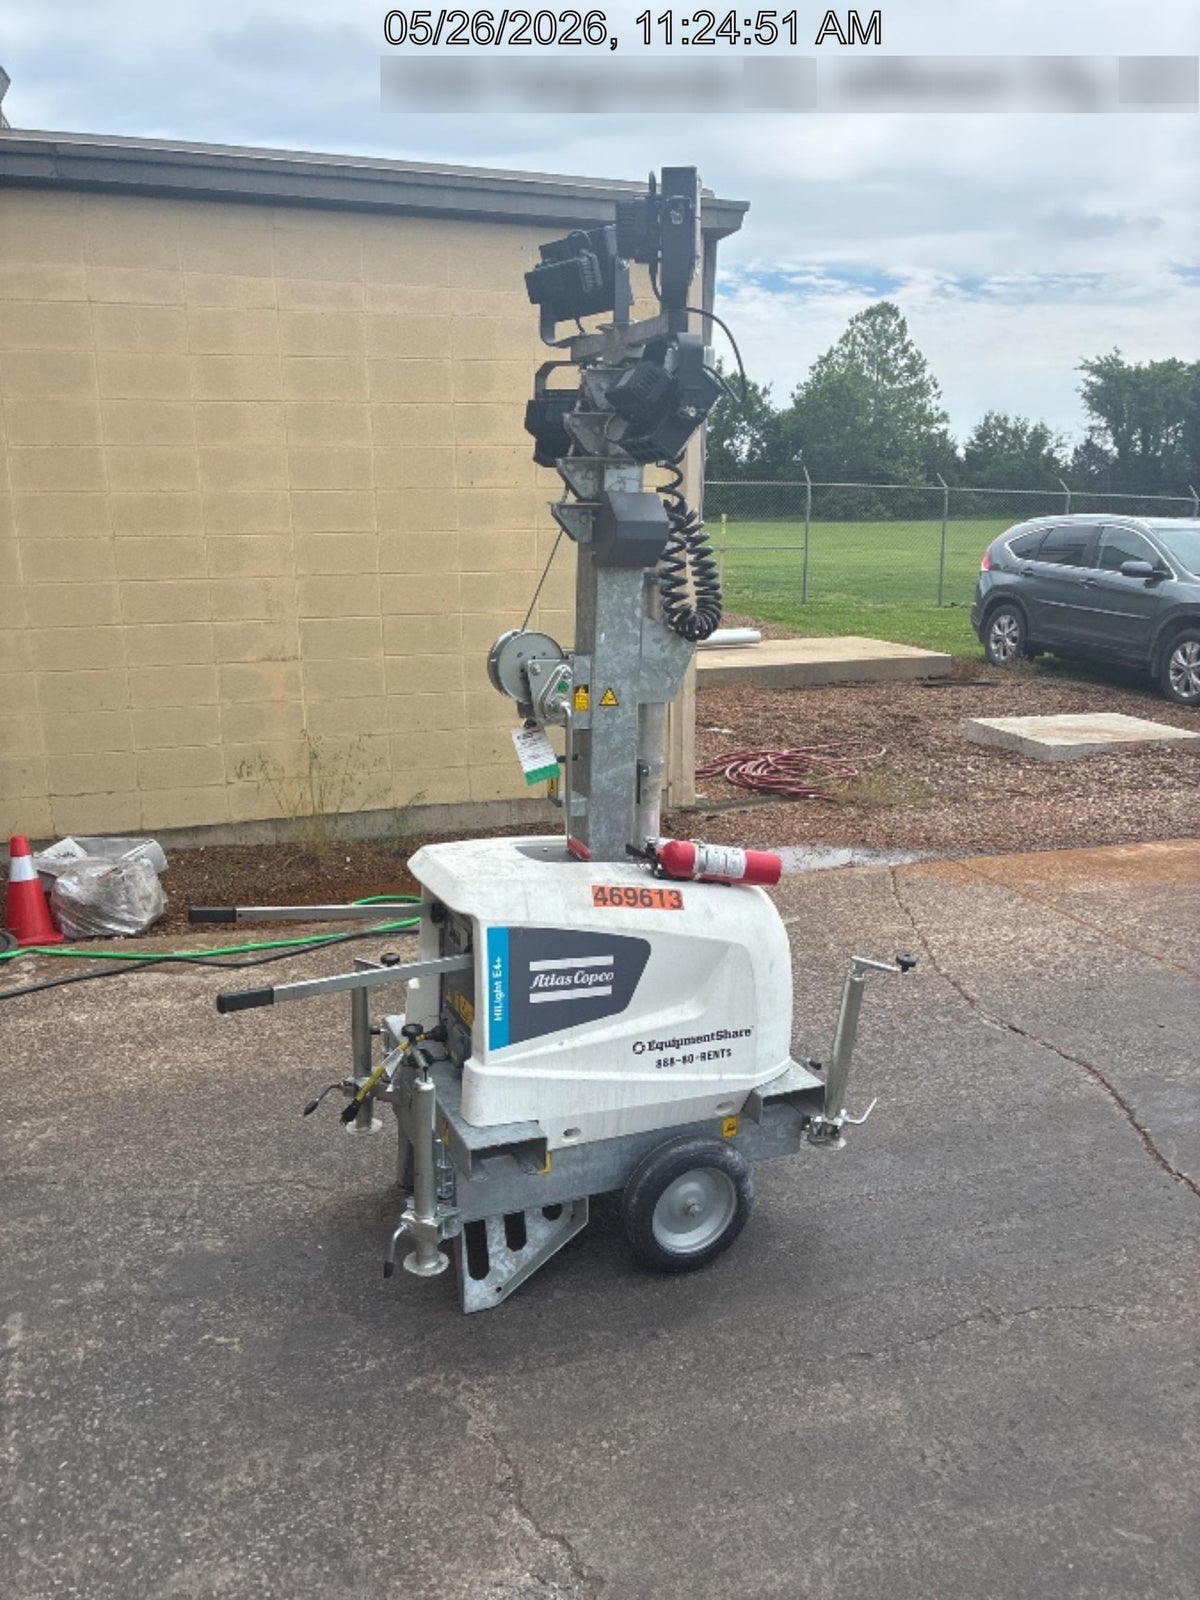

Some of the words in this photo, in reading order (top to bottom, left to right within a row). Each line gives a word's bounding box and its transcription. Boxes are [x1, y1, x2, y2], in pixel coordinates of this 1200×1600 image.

[593, 886, 683, 909] 469613
[529, 973, 572, 989] Atlas
[573, 969, 614, 986] Copco
[647, 1028, 752, 1052] EquipmentShare
